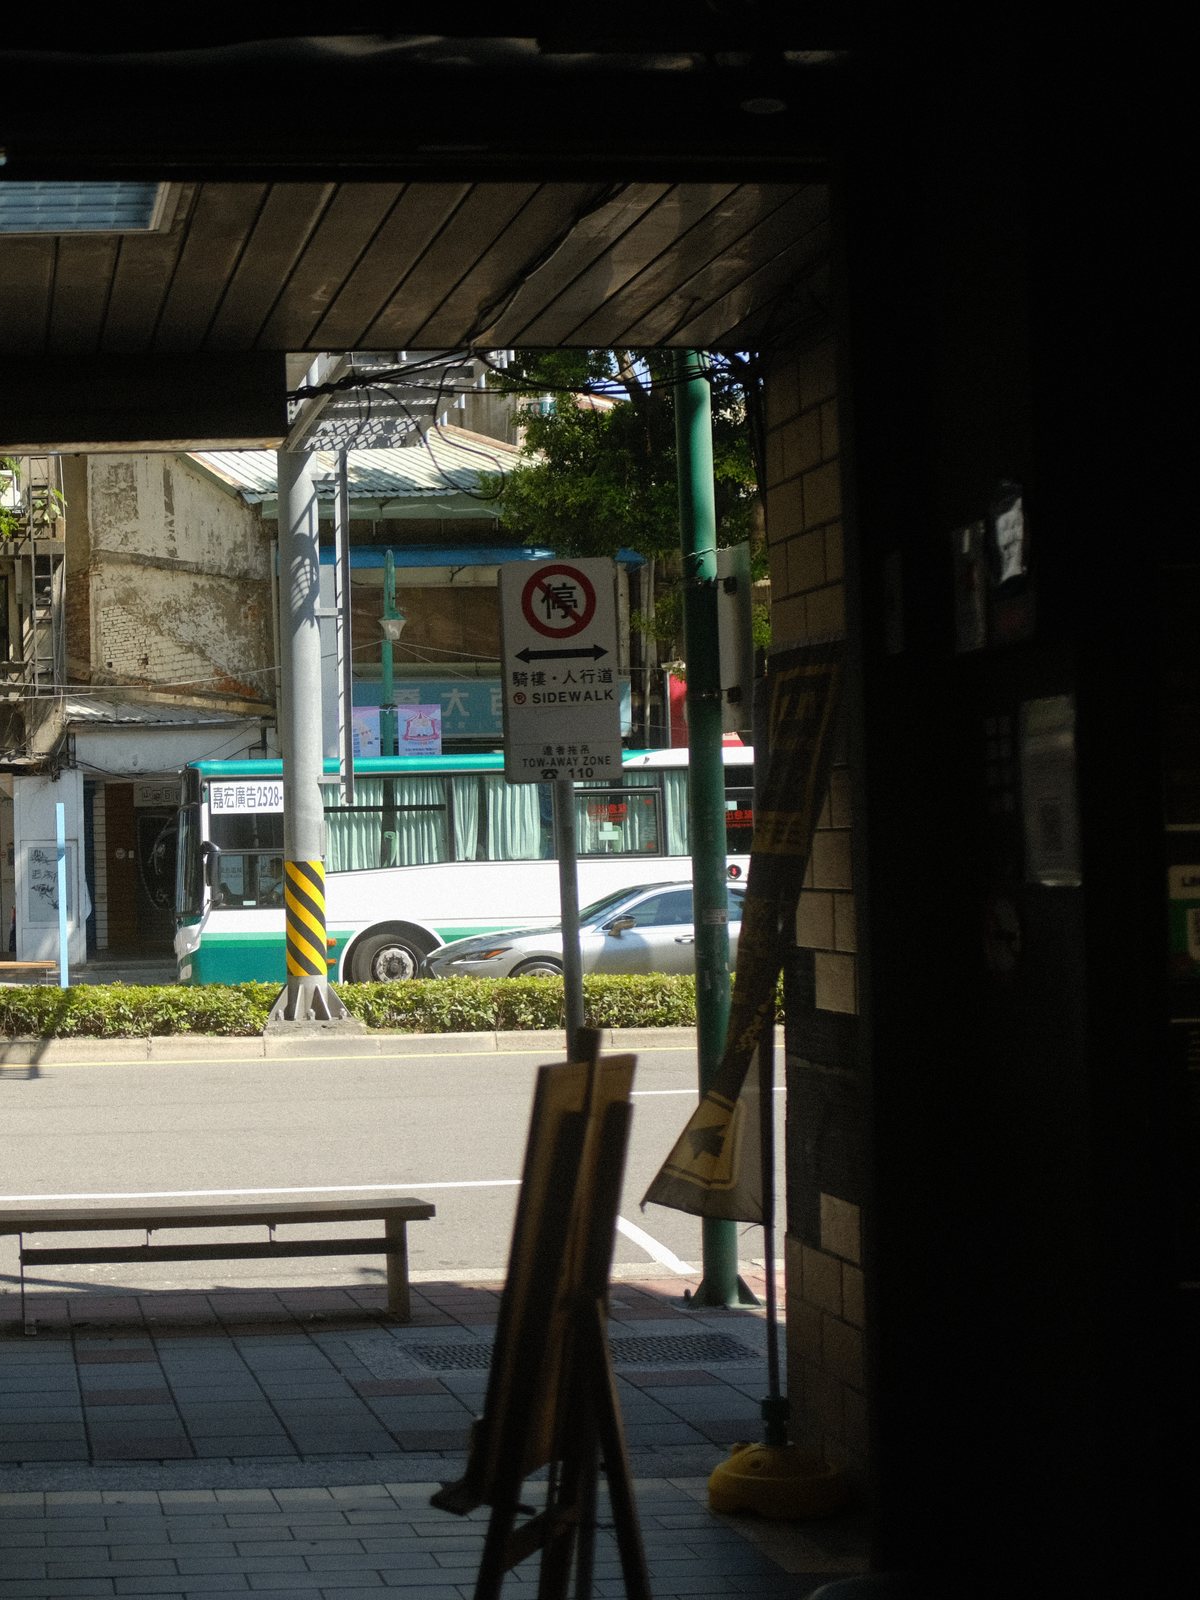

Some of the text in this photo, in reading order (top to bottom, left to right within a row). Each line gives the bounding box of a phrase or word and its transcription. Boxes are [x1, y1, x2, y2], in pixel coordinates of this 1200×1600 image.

[541, 582, 579, 620] 停
[532, 690, 614, 704] SIDEWALK
[522, 756, 611, 768] TOW-AWAY ZONE
[568, 768, 594, 778] 110
